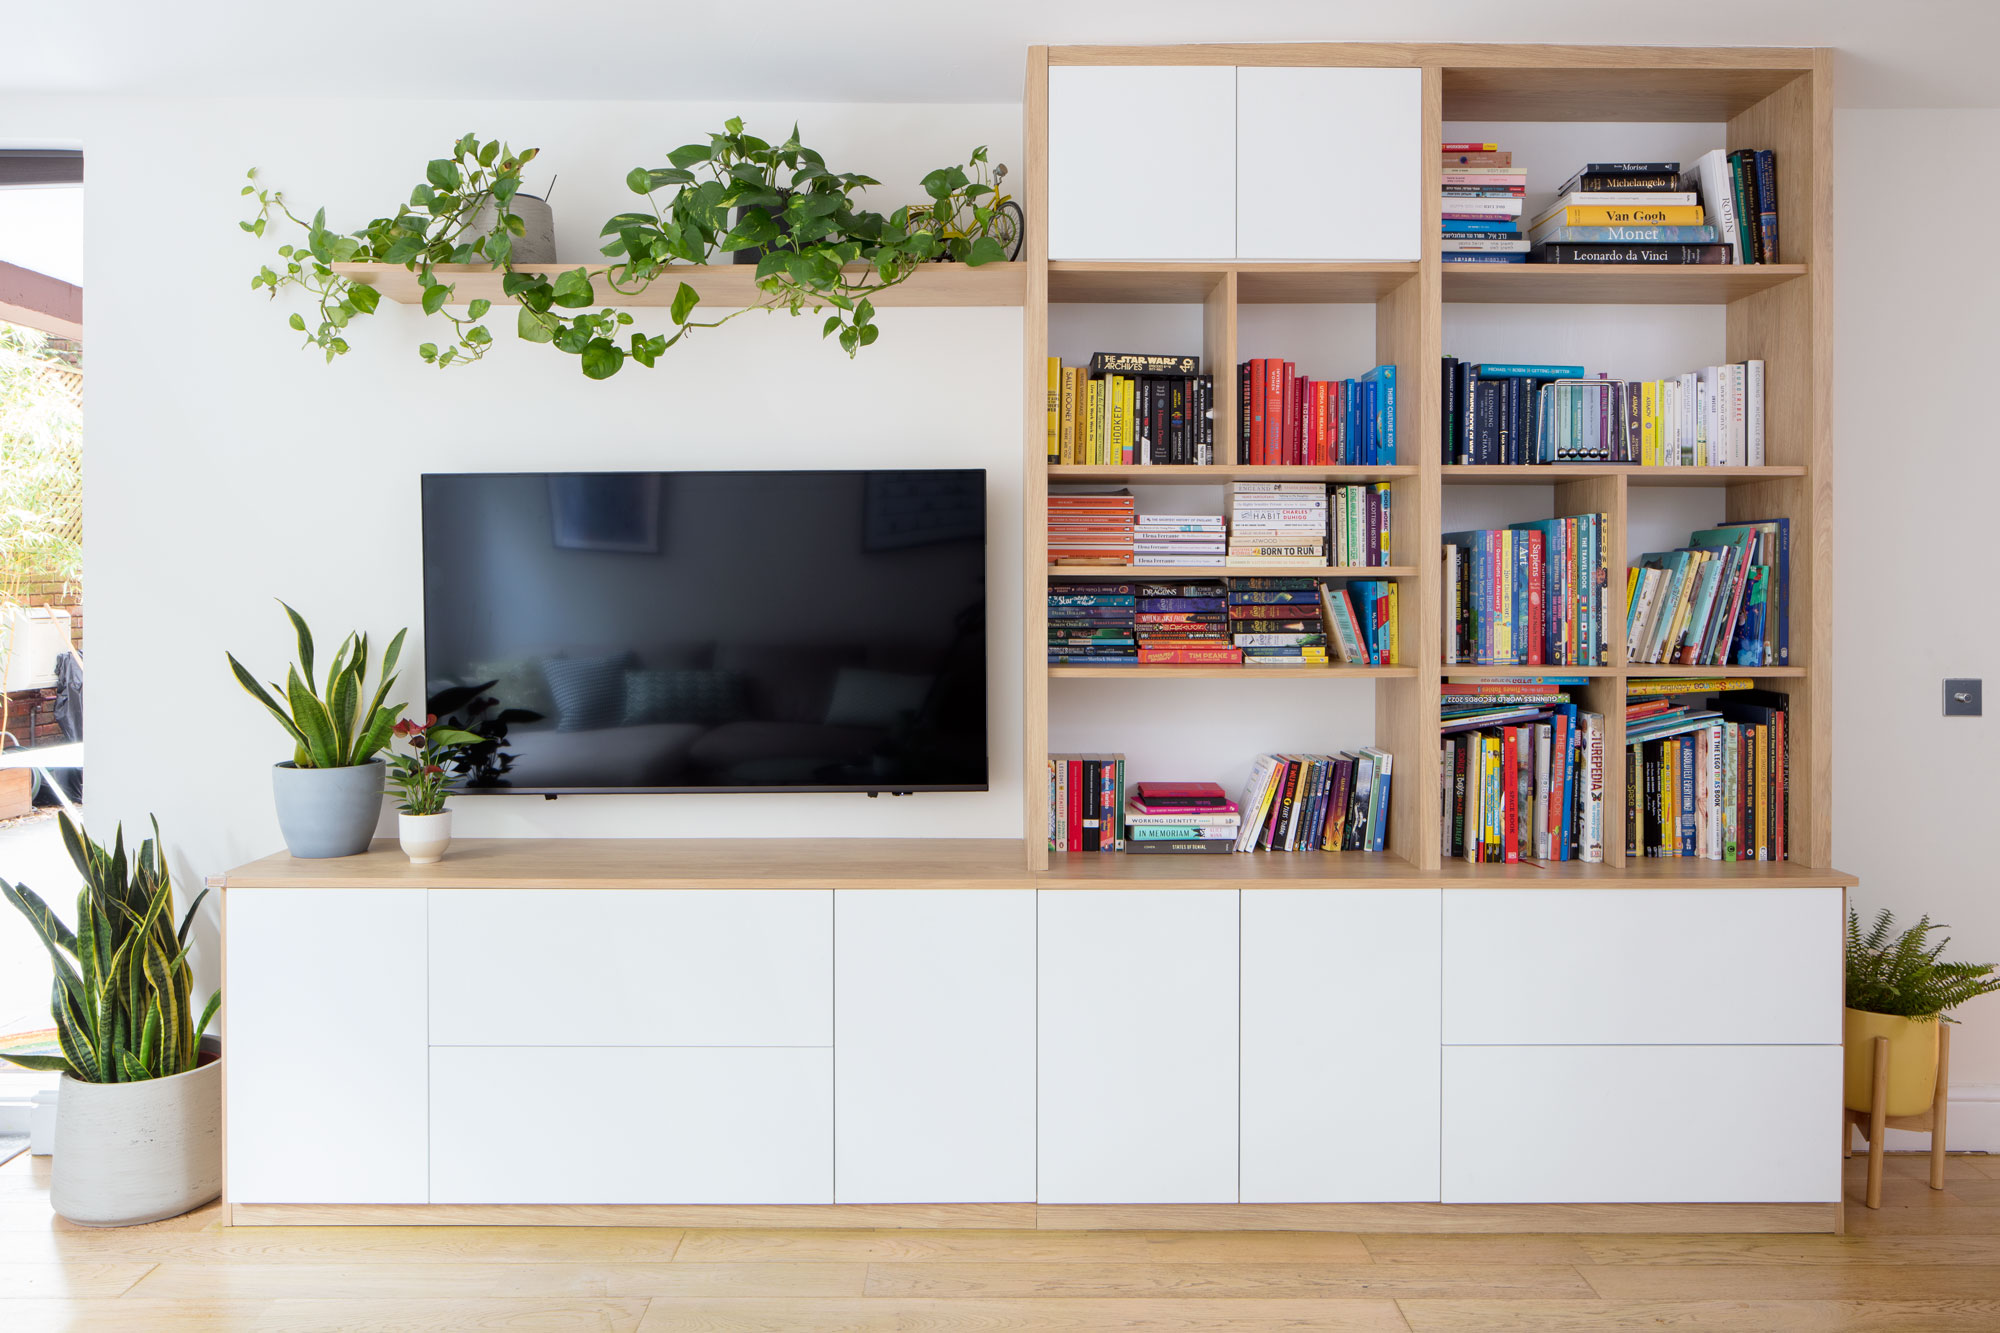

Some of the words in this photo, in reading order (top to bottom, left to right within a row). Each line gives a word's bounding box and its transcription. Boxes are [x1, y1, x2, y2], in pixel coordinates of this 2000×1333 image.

[1606, 177, 1666, 189] Michelangelo
[1605, 211, 1630, 222] Van
[1633, 211, 1667, 225] Gogh
[1721, 197, 1735, 234] RODIN
[1607, 227, 1660, 241] Monet
[1573, 249, 1624, 261] Leonardo
[1625, 250, 1638, 261] da
[1638, 250, 1669, 261] Vinci
[1103, 355, 1116, 363] THE
[1116, 355, 1148, 365] STAR
[1147, 356, 1178, 366] WARS
[1103, 362, 1143, 371] ARCHIVES
[1065, 371, 1074, 391] SALLY
[1065, 392, 1074, 423] ROONEY
[1112, 406, 1122, 444] HOOKED
[1253, 512, 1280, 520] HABIT
[1261, 547, 1283, 556] BORN
[1284, 547, 1295, 556] TO
[1297, 547, 1315, 555] RUN
[1519, 546, 1529, 566] Art
[1530, 543, 1541, 577] Sapiens
[1142, 587, 1177, 597] DRAGONS
[1693, 681, 1727, 690] Science
[1557, 732, 1565, 750] THE
[1446, 751, 1454, 779] RESCUE
[1555, 751, 1564, 788] ANIMAL
[1683, 748, 1693, 780] ABSOLUTELY
[1455, 776, 1465, 796] BOYS
[1627, 784, 1636, 807] Space
[1683, 780, 1693, 812] EVERYTHING!
[1554, 790, 1562, 816] BOOK
[1138, 829, 1147, 838] IN
[1148, 829, 1190, 838] MEMORIAM
[1455, 815, 1464, 846] DIFFERENT
